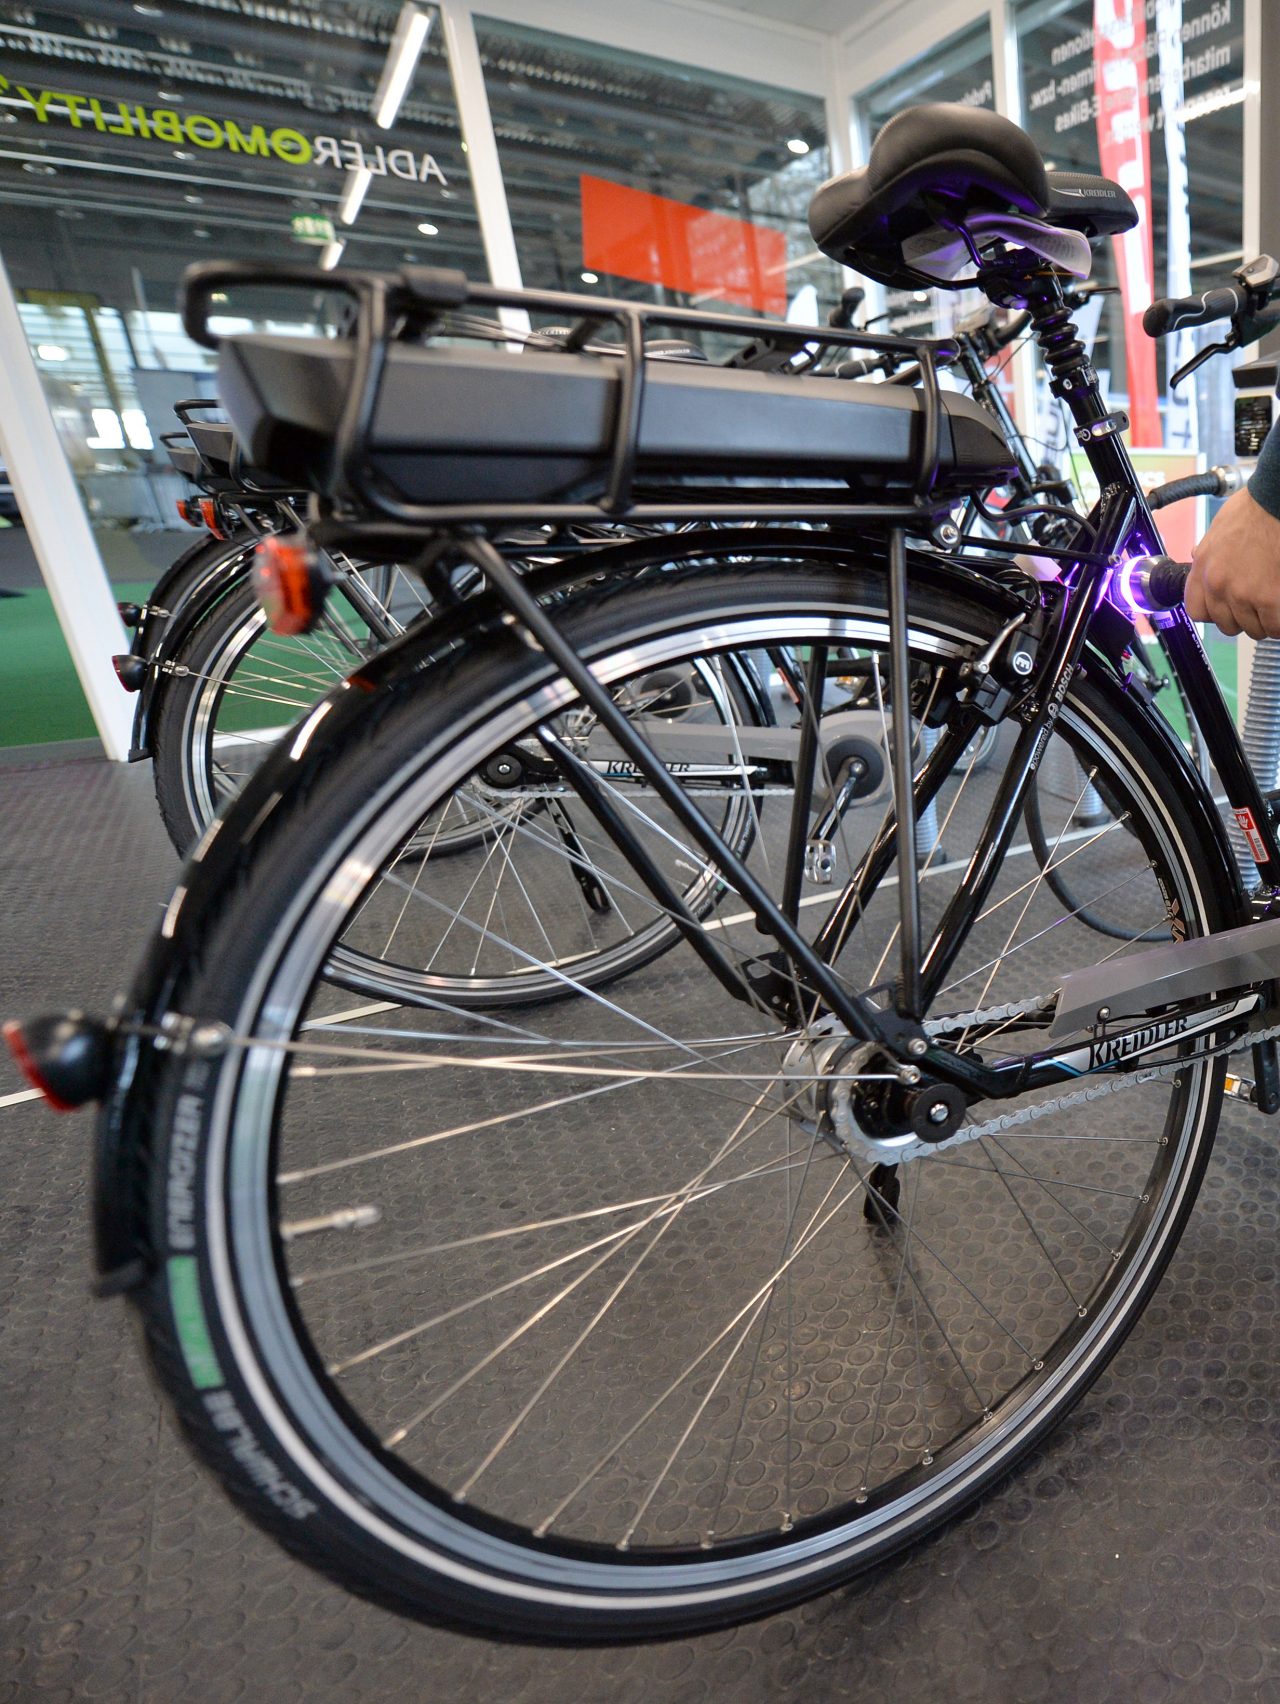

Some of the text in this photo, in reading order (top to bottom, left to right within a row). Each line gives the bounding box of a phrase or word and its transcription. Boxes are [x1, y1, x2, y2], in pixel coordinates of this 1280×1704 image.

[1082, 188, 1117, 199] KREIDLER
[1055, 662, 1075, 702] BOSCH
[606, 760, 690, 775] KREER
[1088, 1015, 1188, 1071] KREIDLER
[203, 1389, 318, 1520] SCHWALBE
